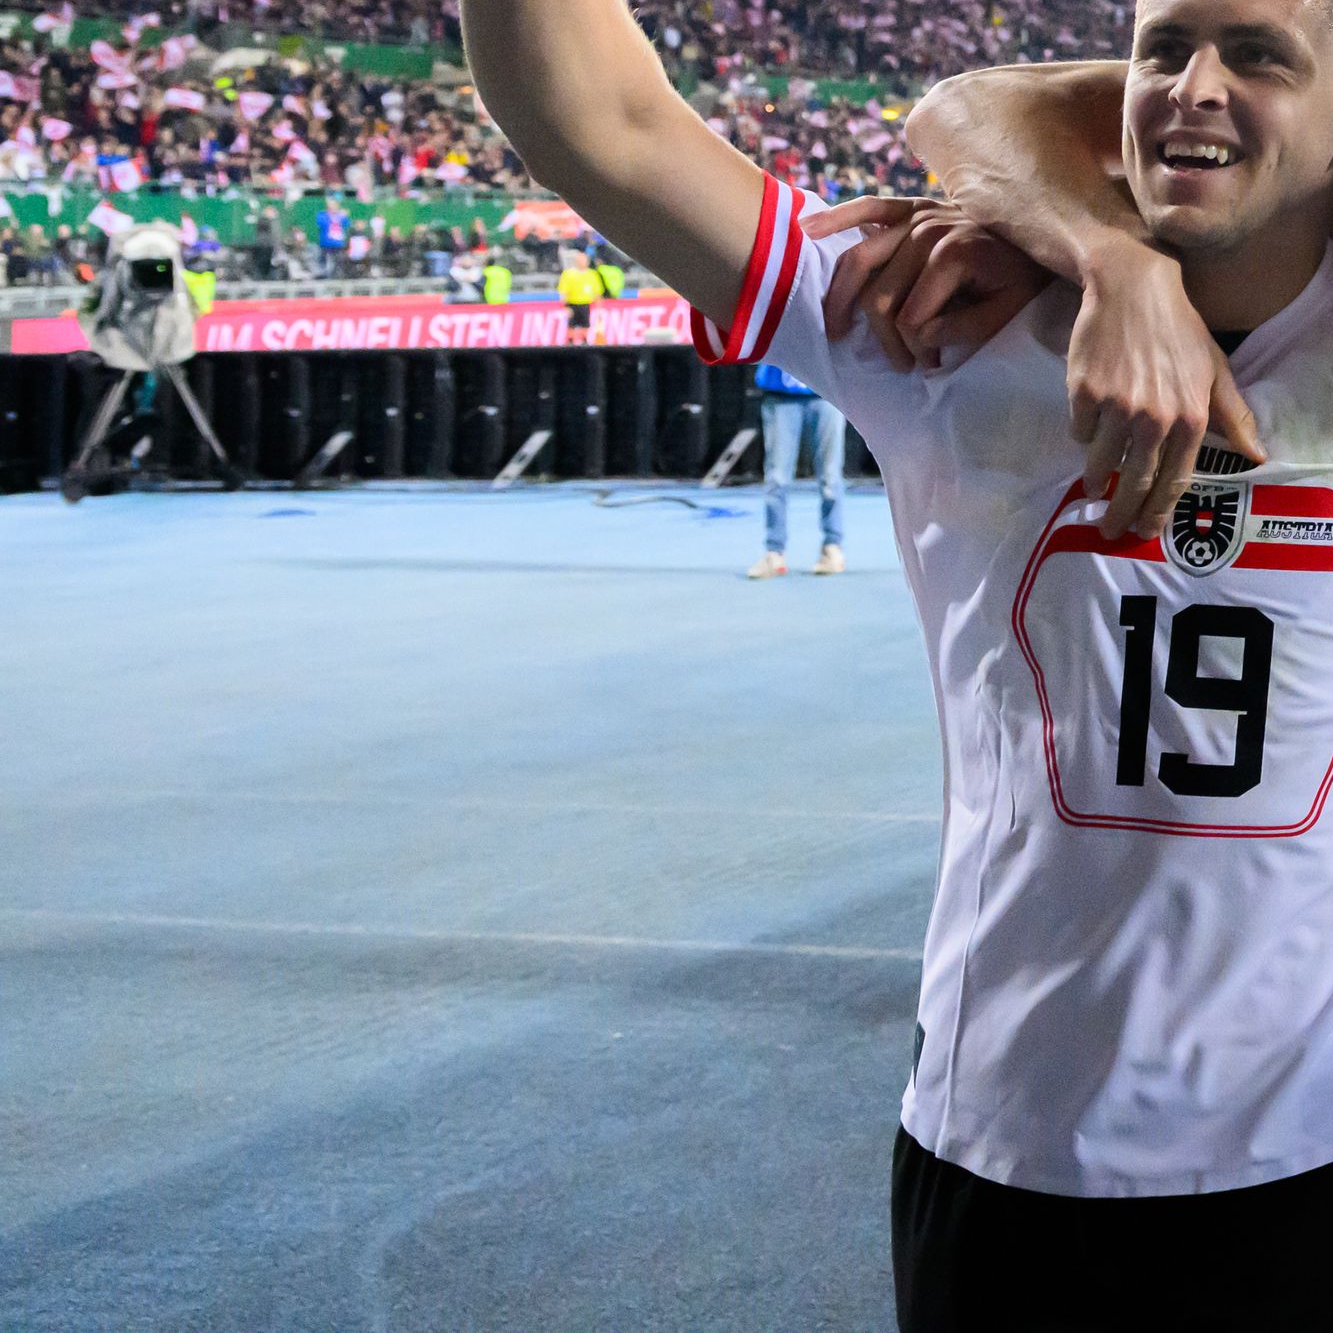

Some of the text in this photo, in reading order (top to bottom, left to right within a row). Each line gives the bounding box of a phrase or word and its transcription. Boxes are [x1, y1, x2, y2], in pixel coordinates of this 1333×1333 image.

[206, 322, 254, 351] IM
[261, 314, 514, 350] SCHNELLSTEN
[519, 307, 666, 346] INTRNET
[1256, 519, 1333, 541] AUSTRIA
[1115, 594, 1275, 798] 19
